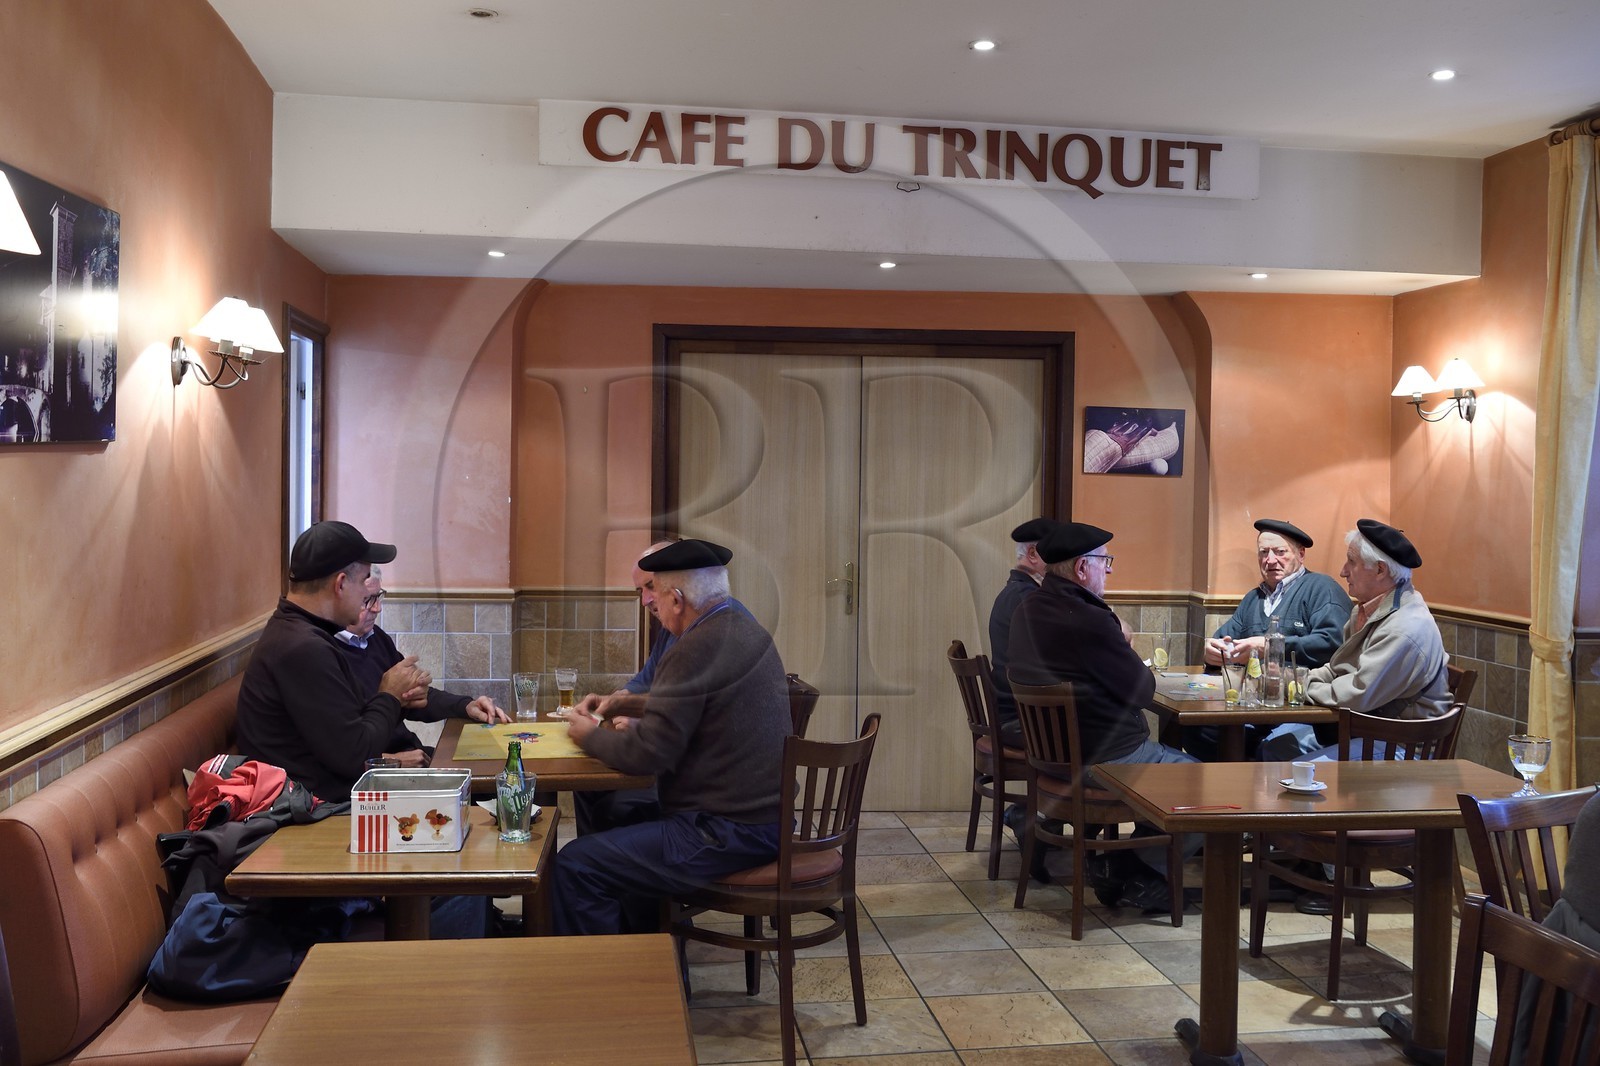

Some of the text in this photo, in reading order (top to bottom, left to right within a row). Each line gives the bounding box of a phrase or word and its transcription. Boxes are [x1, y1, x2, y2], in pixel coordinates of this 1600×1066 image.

[582, 107, 1223, 200] CAFE DU TRINQUET
